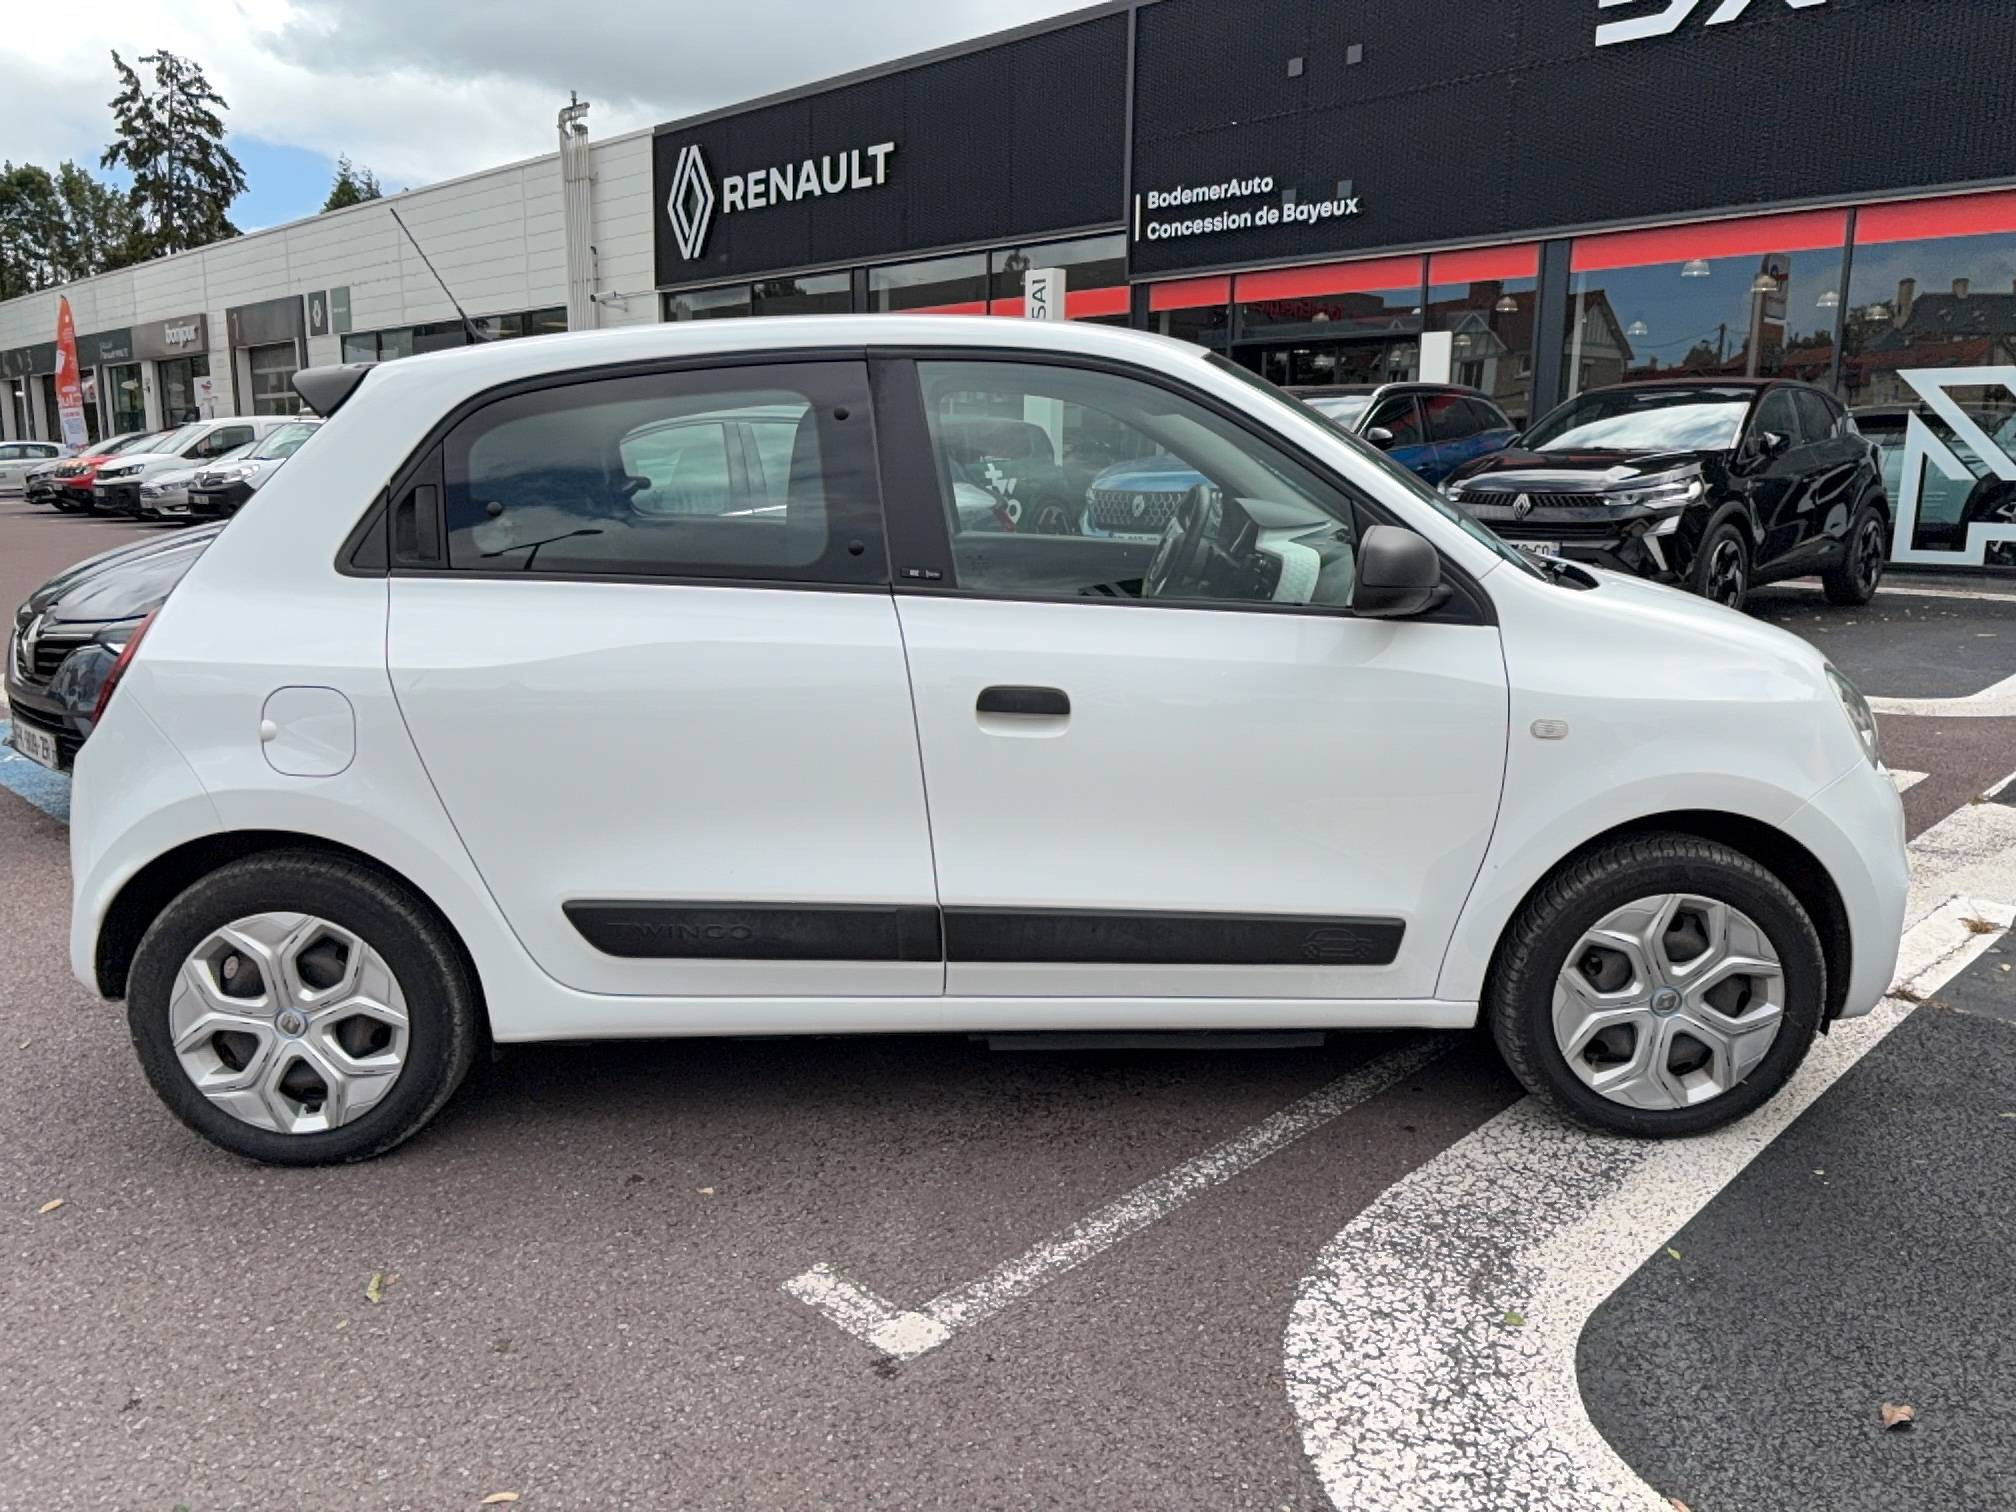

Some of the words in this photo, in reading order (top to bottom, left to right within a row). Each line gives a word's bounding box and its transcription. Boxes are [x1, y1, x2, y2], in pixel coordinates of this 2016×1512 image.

[723, 141, 895, 214] RENAULT
[1147, 176, 1274, 209] BodemerAuto
[1147, 211, 1252, 240] Concession
[1255, 205, 1280, 226] de
[1282, 196, 1360, 225] Bayeux
